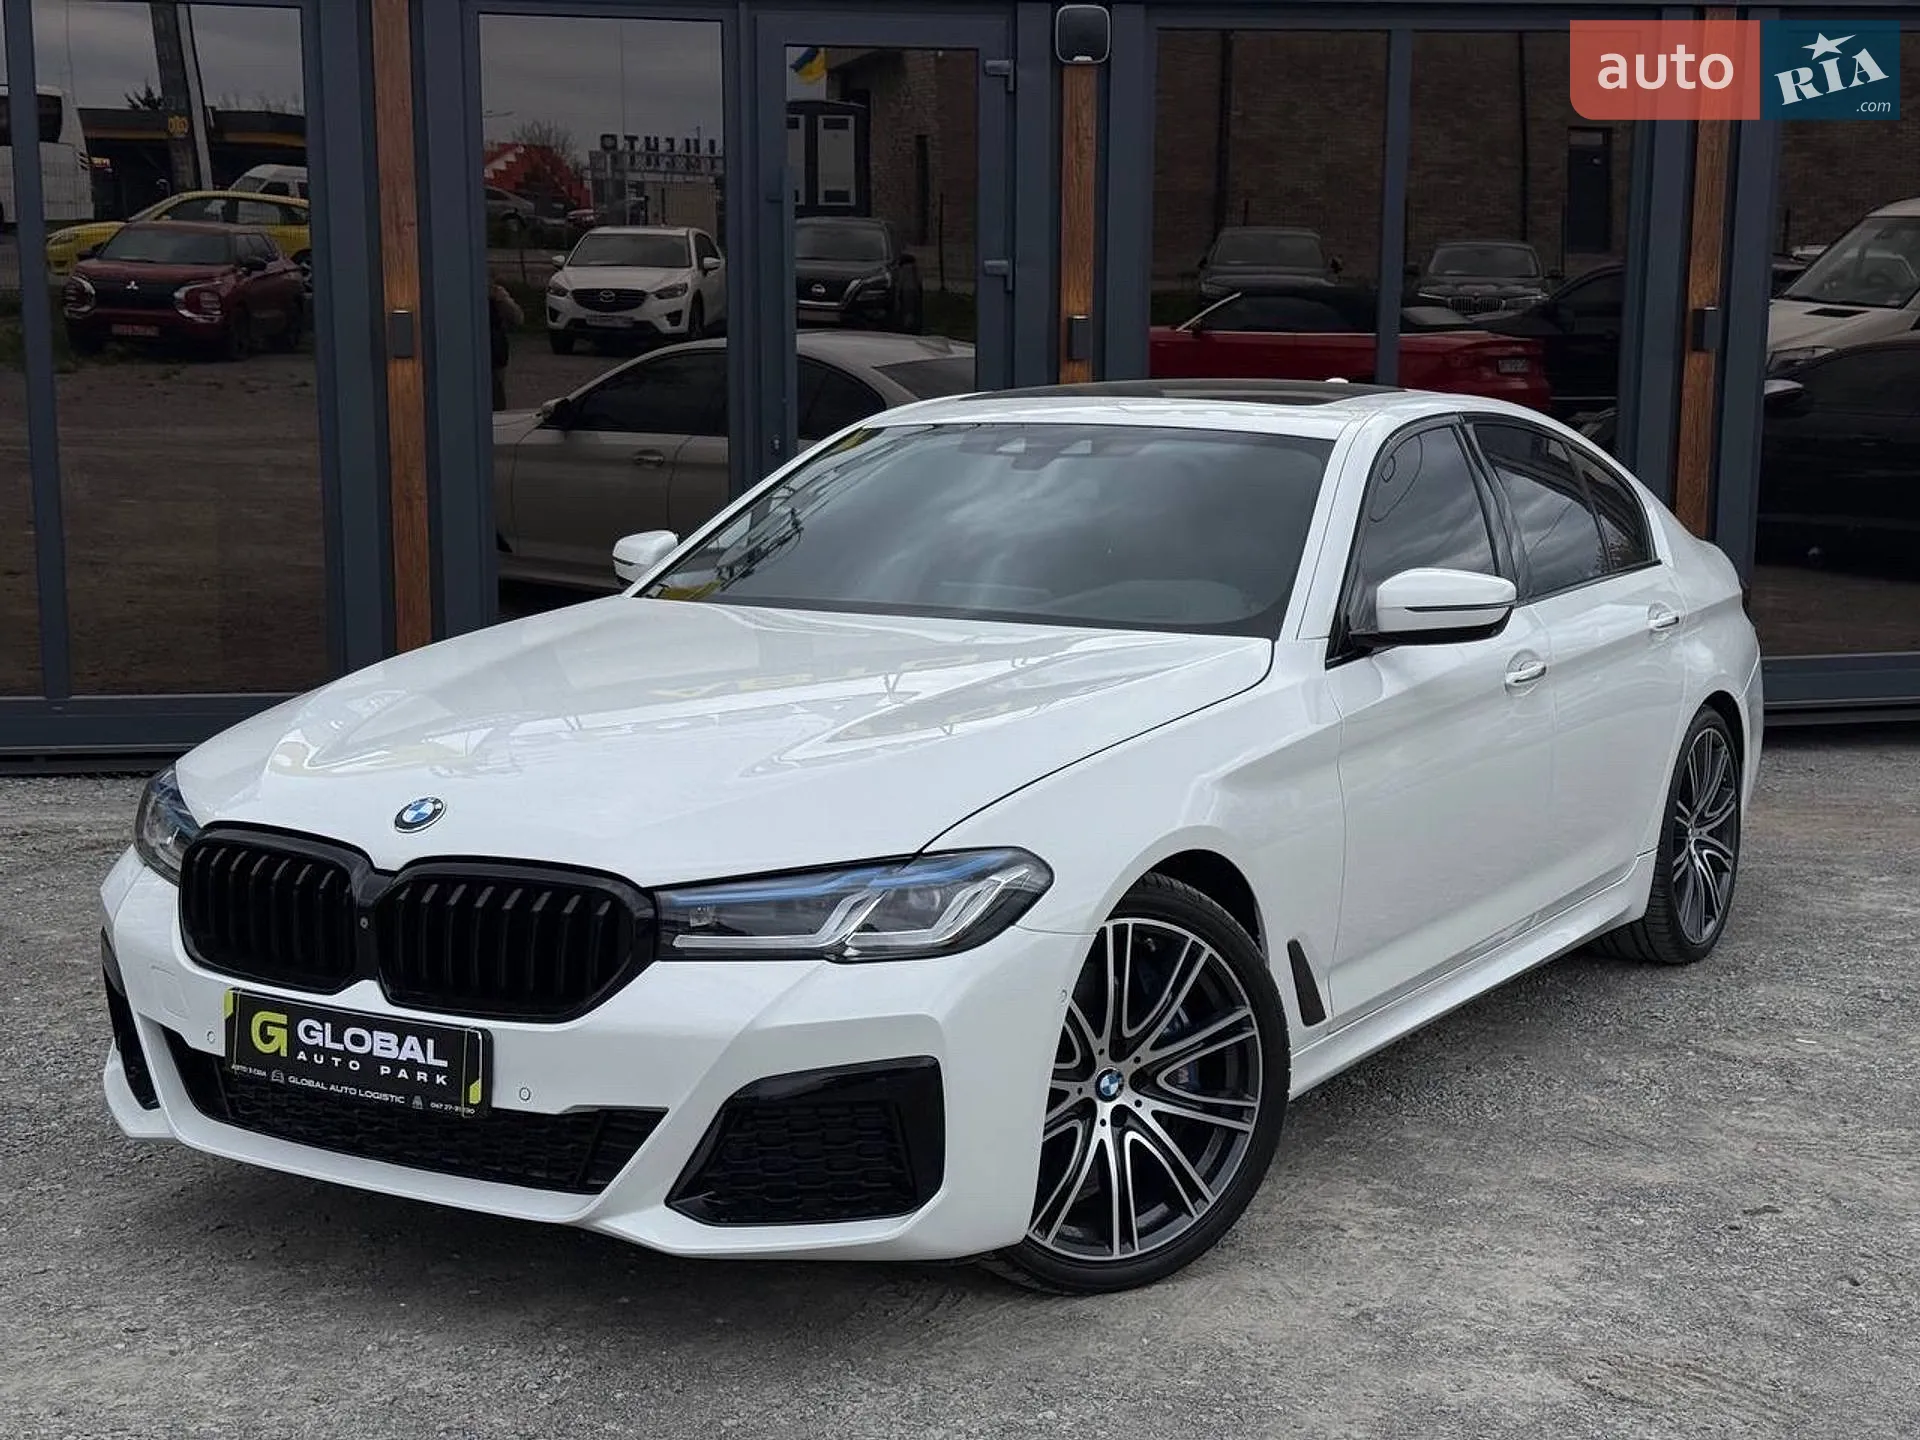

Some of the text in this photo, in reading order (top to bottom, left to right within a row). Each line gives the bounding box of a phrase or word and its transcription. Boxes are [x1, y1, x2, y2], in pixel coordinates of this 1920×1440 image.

[297, 1018, 449, 1067] GLOBAL
[296, 1051, 448, 1086] AUTO PARK
[288, 1075, 405, 1104] GLOBAL AUTO LOGISTIC
